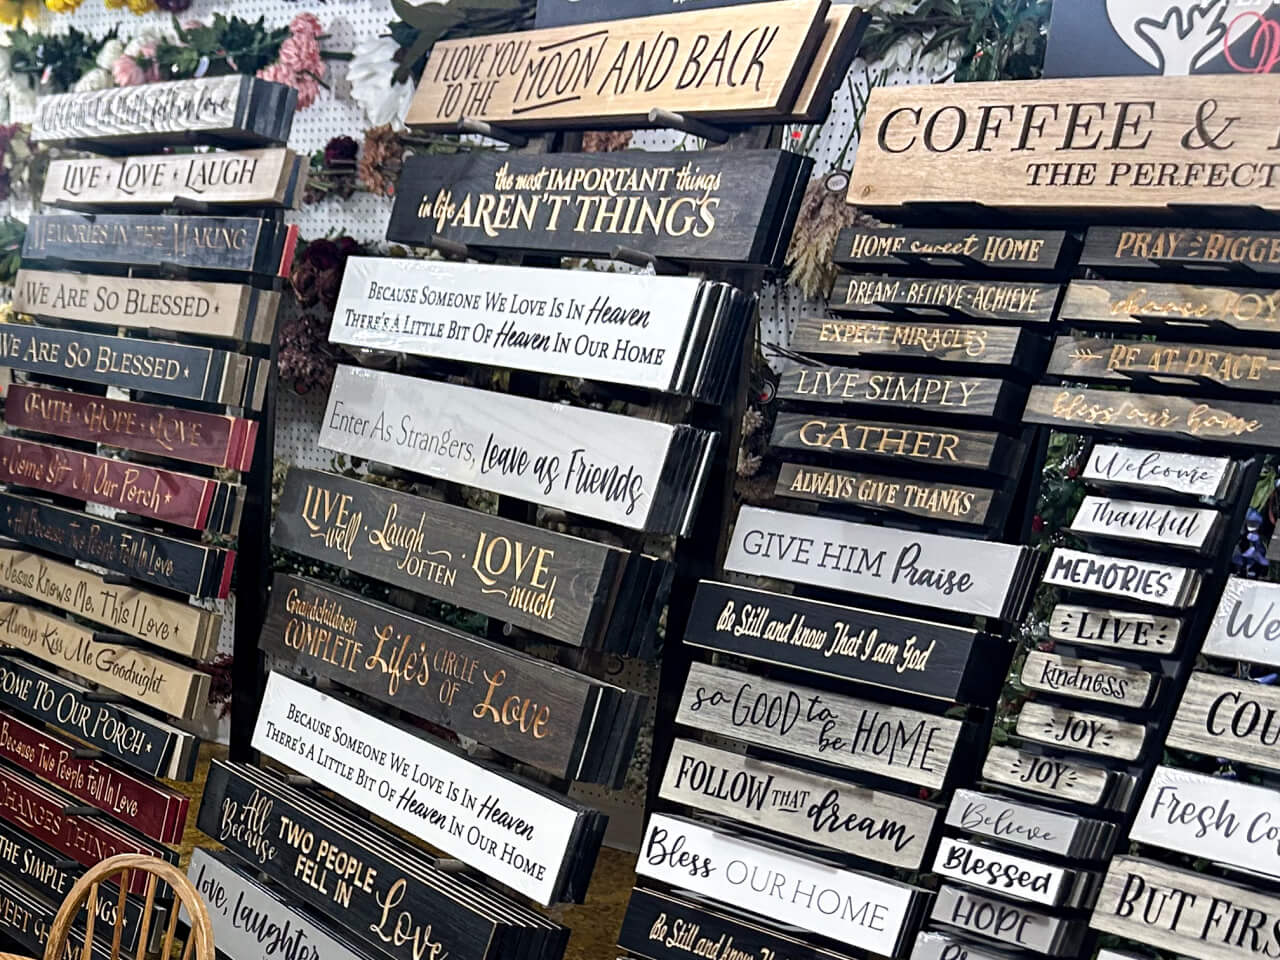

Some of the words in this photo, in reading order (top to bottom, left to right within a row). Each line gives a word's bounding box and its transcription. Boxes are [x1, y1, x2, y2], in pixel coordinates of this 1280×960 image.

[434, 49, 446, 83] I
[445, 44, 489, 81] LOVE
[491, 39, 531, 77] YOU
[513, 36, 605, 102] MOON
[597, 31, 679, 96] AND
[676, 25, 780, 91] BACK
[437, 82, 463, 118] TO
[462, 79, 499, 118] THE
[878, 100, 1155, 153] COFFEE
[1181, 99, 1240, 151] &
[495, 162, 514, 189] the
[515, 170, 546, 191] most
[547, 168, 674, 196] IMPORTANT
[676, 161, 722, 204] things
[1026, 163, 1097, 186] THE
[1105, 163, 1280, 187] PERFECT
[418, 195, 432, 218] in
[431, 189, 455, 233] life
[451, 195, 571, 238] AREN'T
[573, 196, 720, 238] THINGS
[1115, 232, 1183, 258] PRAY
[820, 324, 889, 343] EXPECT
[892, 327, 987, 356] MIRACLES
[1107, 345, 1141, 371] BE
[1148, 350, 1179, 371] AT
[1185, 350, 1267, 381] PEACE
[797, 370, 860, 398] LIVE
[866, 375, 980, 408] SIMPLY
[329, 401, 369, 434] Enter
[369, 412, 392, 441] As
[395, 415, 475, 468] Strangers,
[534, 457, 559, 494] as
[564, 449, 645, 515] Friends
[800, 420, 961, 461] GATHER
[1094, 452, 1214, 482] Welcome
[791, 470, 856, 498] ALWAYS
[858, 479, 899, 504] GIVE
[904, 484, 974, 516] THANKS
[301, 485, 353, 529] LIVE
[369, 503, 424, 557] Laugh
[472, 532, 554, 589] LOVE
[1091, 501, 1200, 537] Thankful
[325, 508, 359, 560] well
[396, 555, 456, 587] OFTEN
[508, 575, 556, 620] much
[743, 531, 814, 564] GIVE
[817, 542, 887, 577] HIM
[892, 543, 973, 595] Praise
[1050, 555, 1173, 597] MEMORIES
[5, 561, 33, 590] Jesus
[37, 565, 72, 609] Knows
[73, 581, 94, 614] Me,
[100, 589, 128, 625] This
[132, 599, 139, 628] I
[140, 604, 170, 639] Love
[286, 588, 358, 635] Grandchildren
[366, 624, 430, 696] Life's
[433, 646, 479, 685] CIRCLE
[1077, 612, 1154, 646] LIVE
[40, 623, 64, 655] Kiss
[65, 642, 93, 666] Me
[96, 647, 167, 696] Goodnight
[285, 619, 363, 673] COMPLETE
[439, 679, 460, 706] OF
[473, 669, 551, 738] Love
[1040, 660, 1128, 699] kindness
[1056, 716, 1103, 749] JOY
[674, 755, 774, 811] FOLLOW
[772, 788, 810, 808] THAT
[808, 790, 915, 852] dream
[961, 802, 1057, 841] Believe
[1151, 786, 1241, 839] Fresh
[221, 798, 278, 862] Because
[294, 854, 329, 894] FELL
[334, 881, 353, 908] IN
[241, 790, 274, 835] All
[279, 816, 313, 853] TWO
[316, 840, 377, 893] PEOPLE
[648, 826, 715, 879] Bless
[726, 860, 786, 899] OUR
[792, 880, 889, 932] HOME
[943, 846, 1051, 894] Blessed
[952, 892, 1032, 943] HOPE
[1116, 874, 1195, 931] BUT
